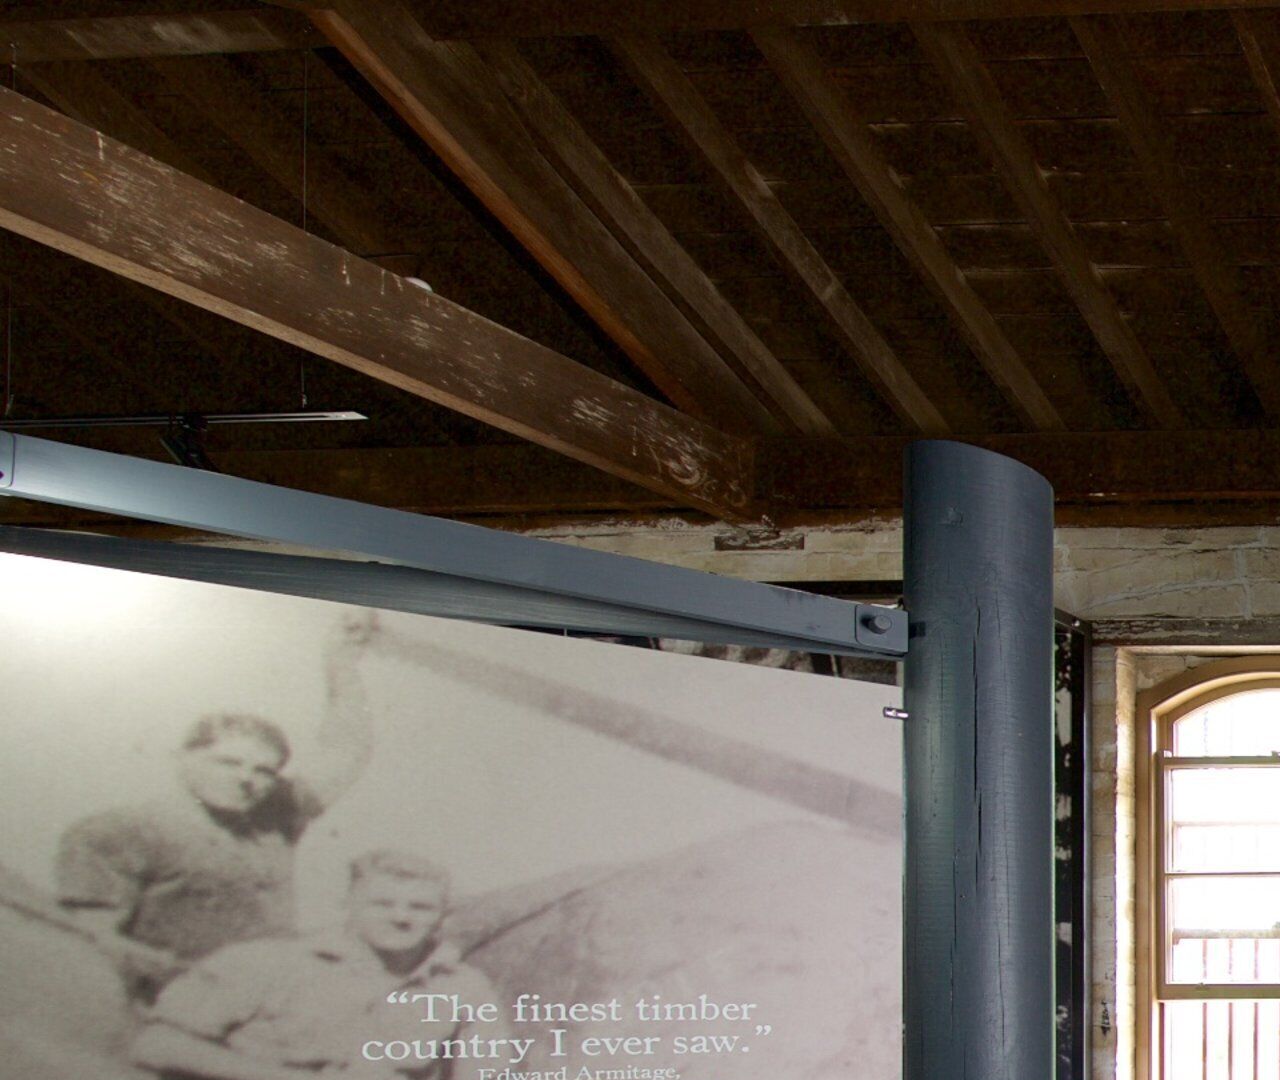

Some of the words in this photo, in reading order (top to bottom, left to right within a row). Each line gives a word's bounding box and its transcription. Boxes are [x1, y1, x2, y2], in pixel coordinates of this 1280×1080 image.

[386, 991, 499, 1023] “The
[512, 993, 622, 1022] finest
[635, 993, 757, 1021] timber
[361, 1033, 535, 1062] country
[549, 1029, 568, 1056] I
[581, 1035, 661, 1056] ever
[673, 1025, 772, 1055] saw.”
